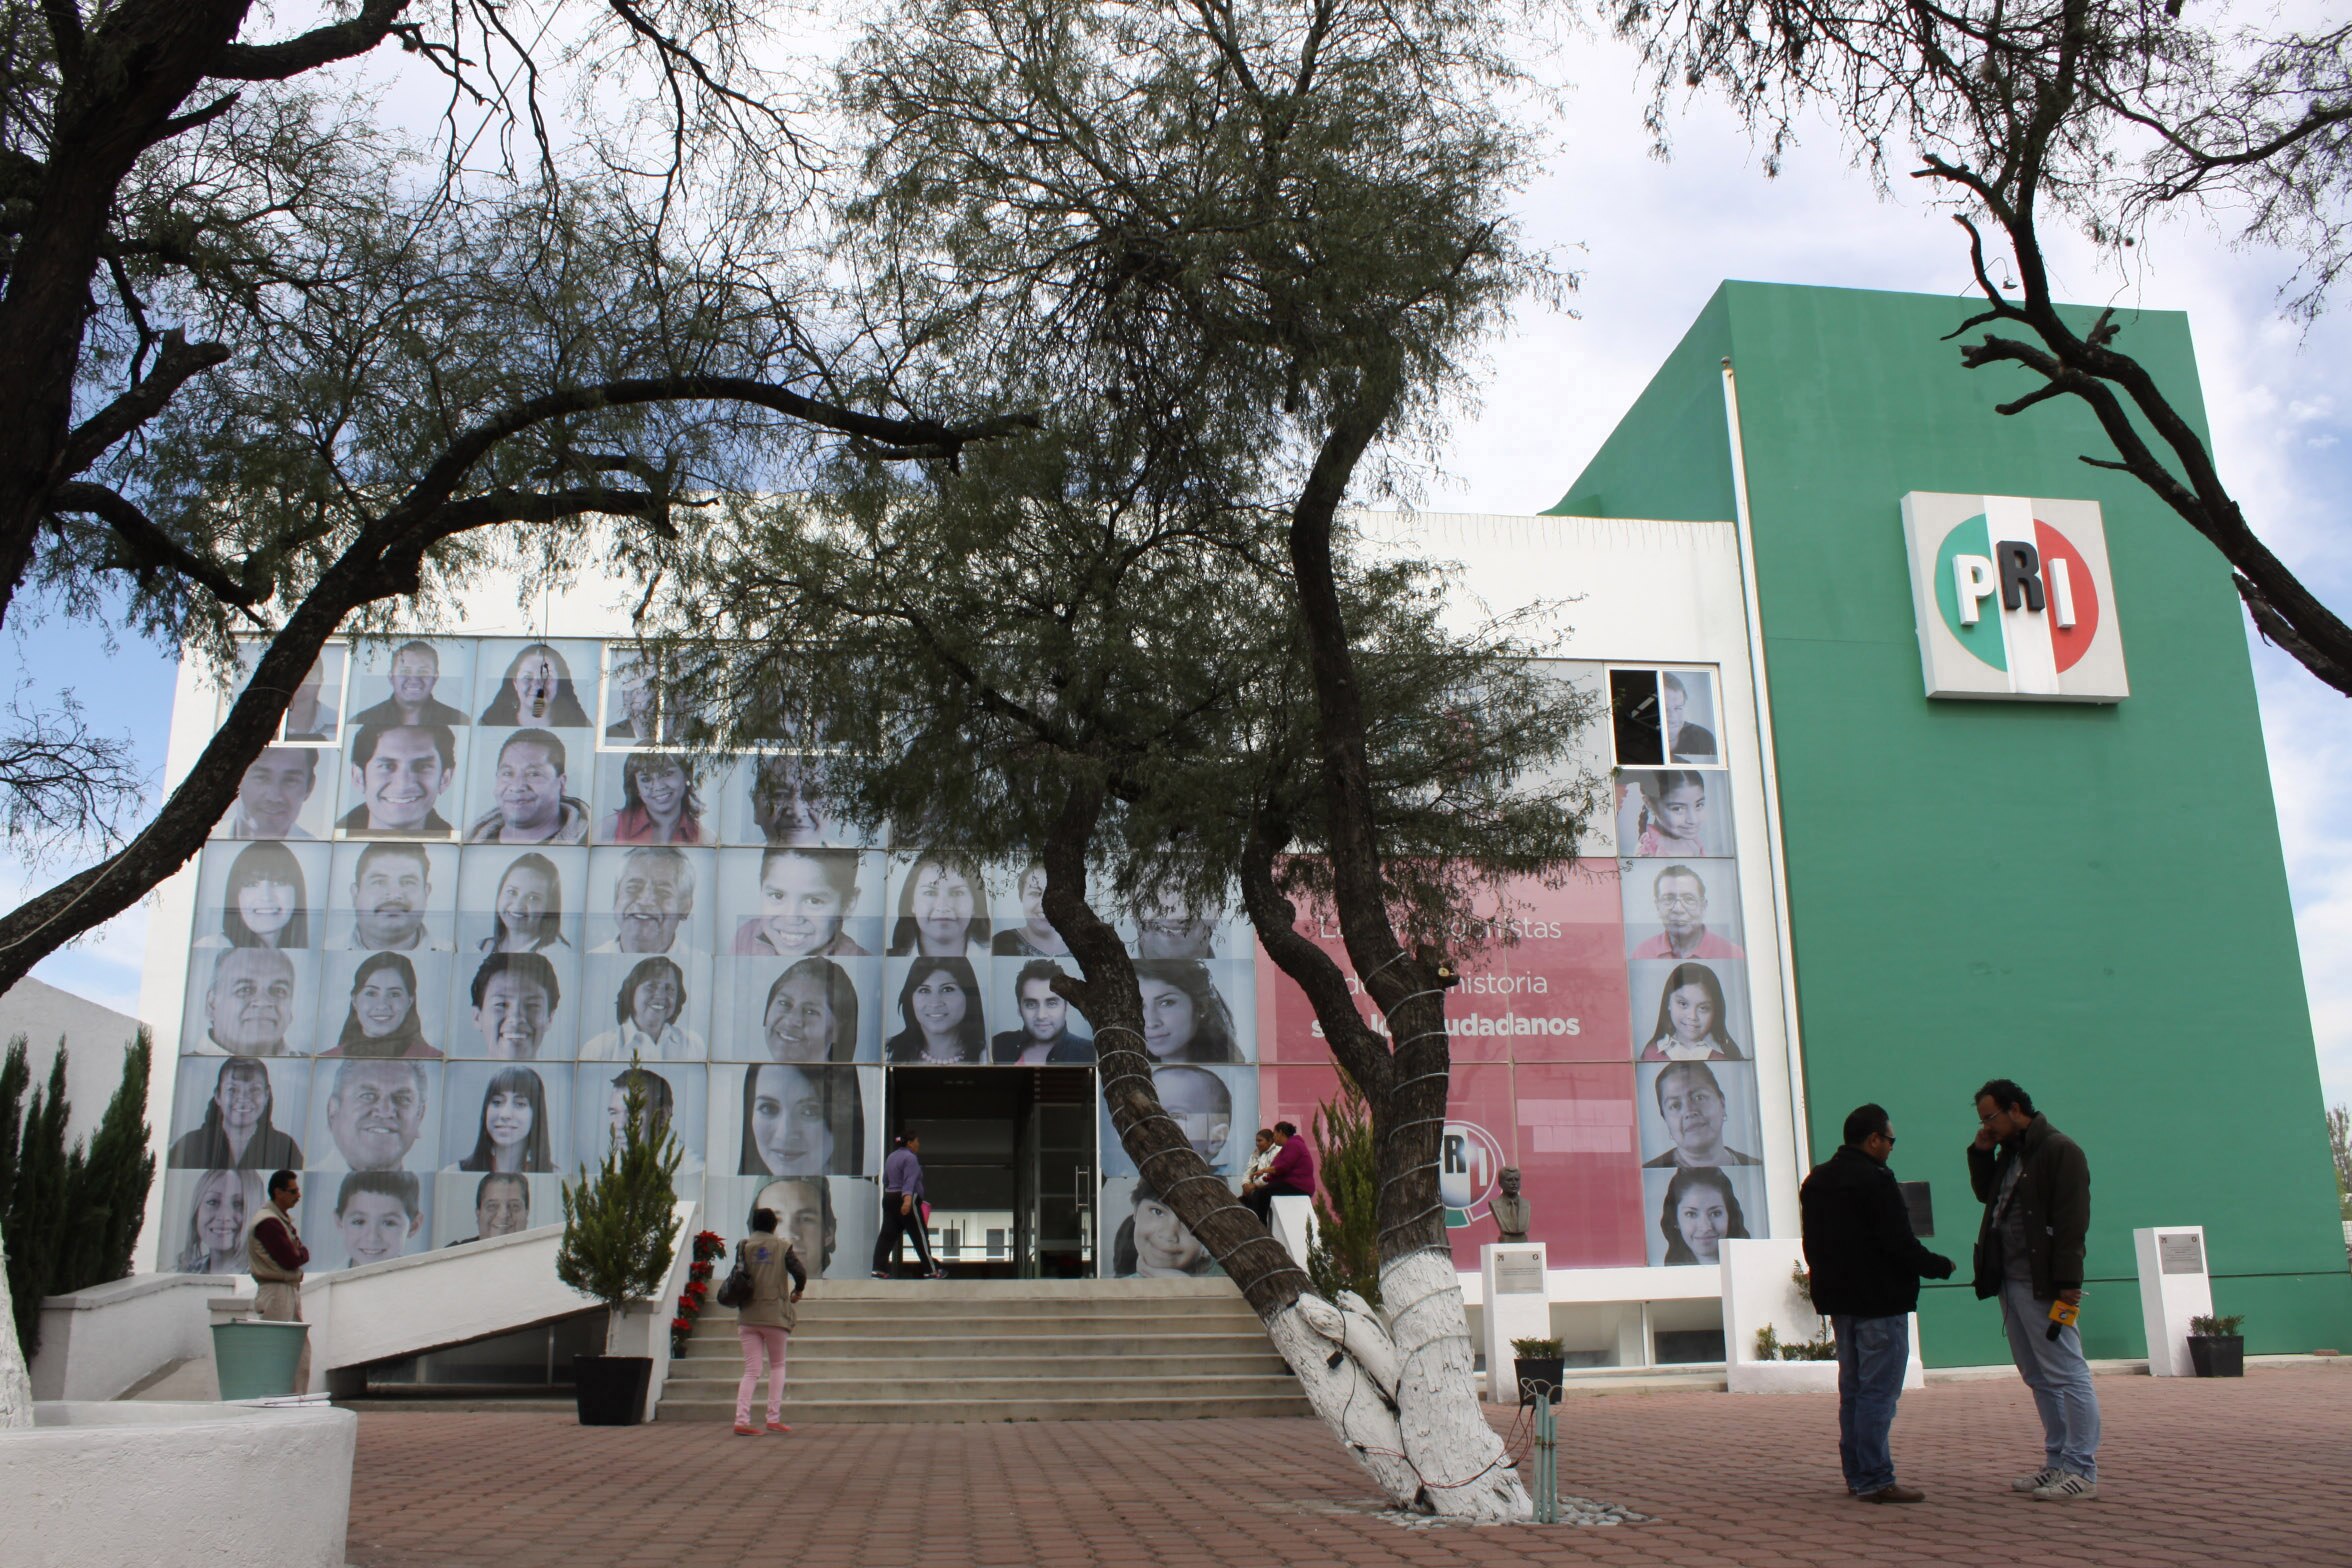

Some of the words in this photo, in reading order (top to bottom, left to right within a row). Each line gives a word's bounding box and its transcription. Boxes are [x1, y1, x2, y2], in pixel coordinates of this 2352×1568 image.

[1952, 540, 2076, 628] PRI
[1444, 1013, 1580, 1037] udadanos
[1444, 1135, 1488, 1187] RI
